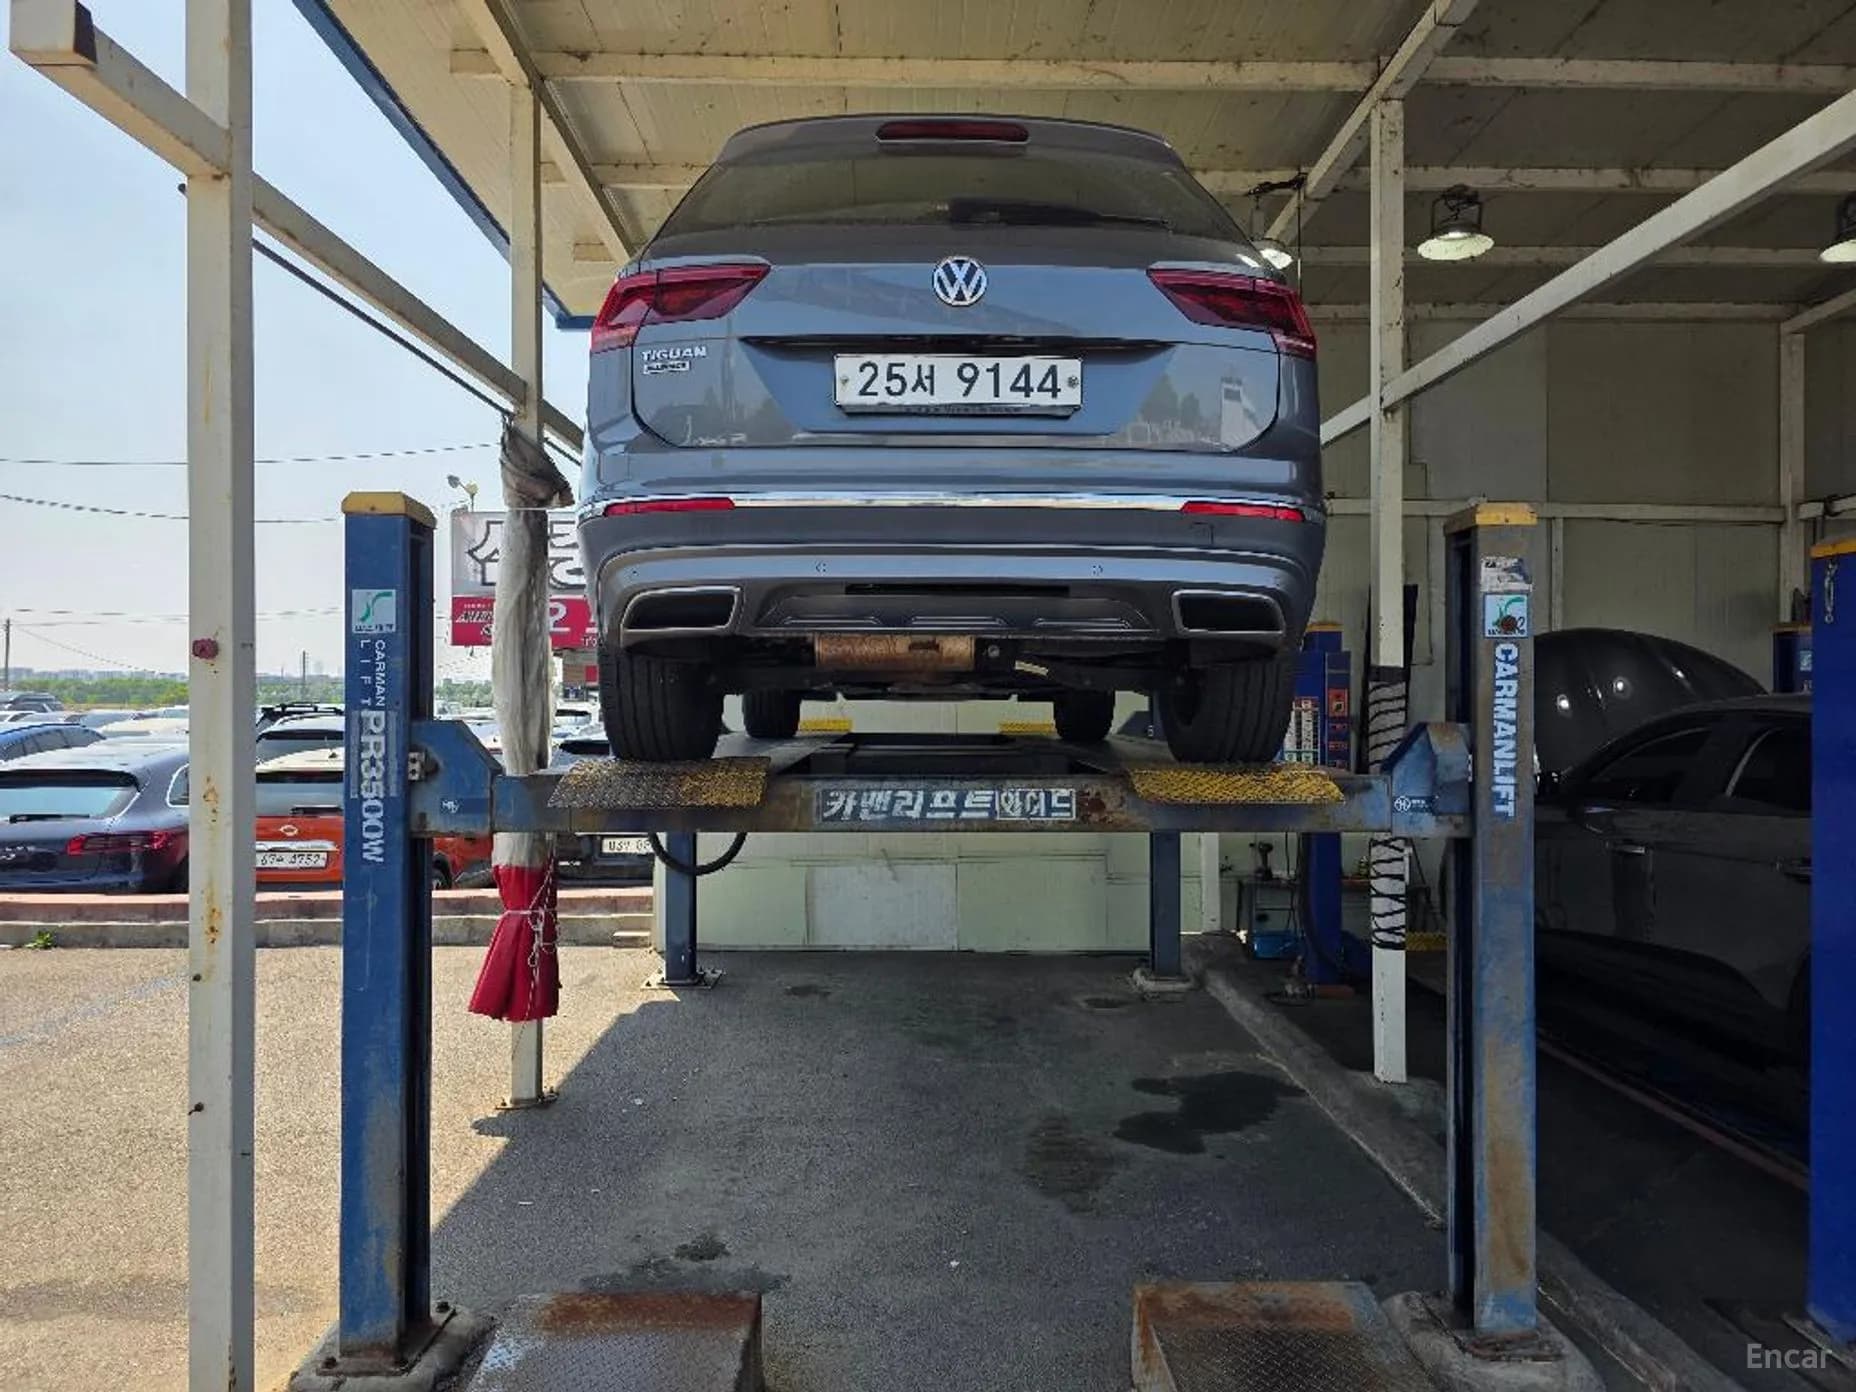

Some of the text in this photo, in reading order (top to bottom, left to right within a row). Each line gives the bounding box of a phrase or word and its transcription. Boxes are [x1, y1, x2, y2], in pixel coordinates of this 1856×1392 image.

[642, 346, 707, 360] TIGUAN
[858, 361, 1062, 399] 25서 9144
[374, 639, 386, 707] CARMAN
[1492, 642, 1519, 817] CARMANLIFT
[360, 709, 386, 863] PR3500W
